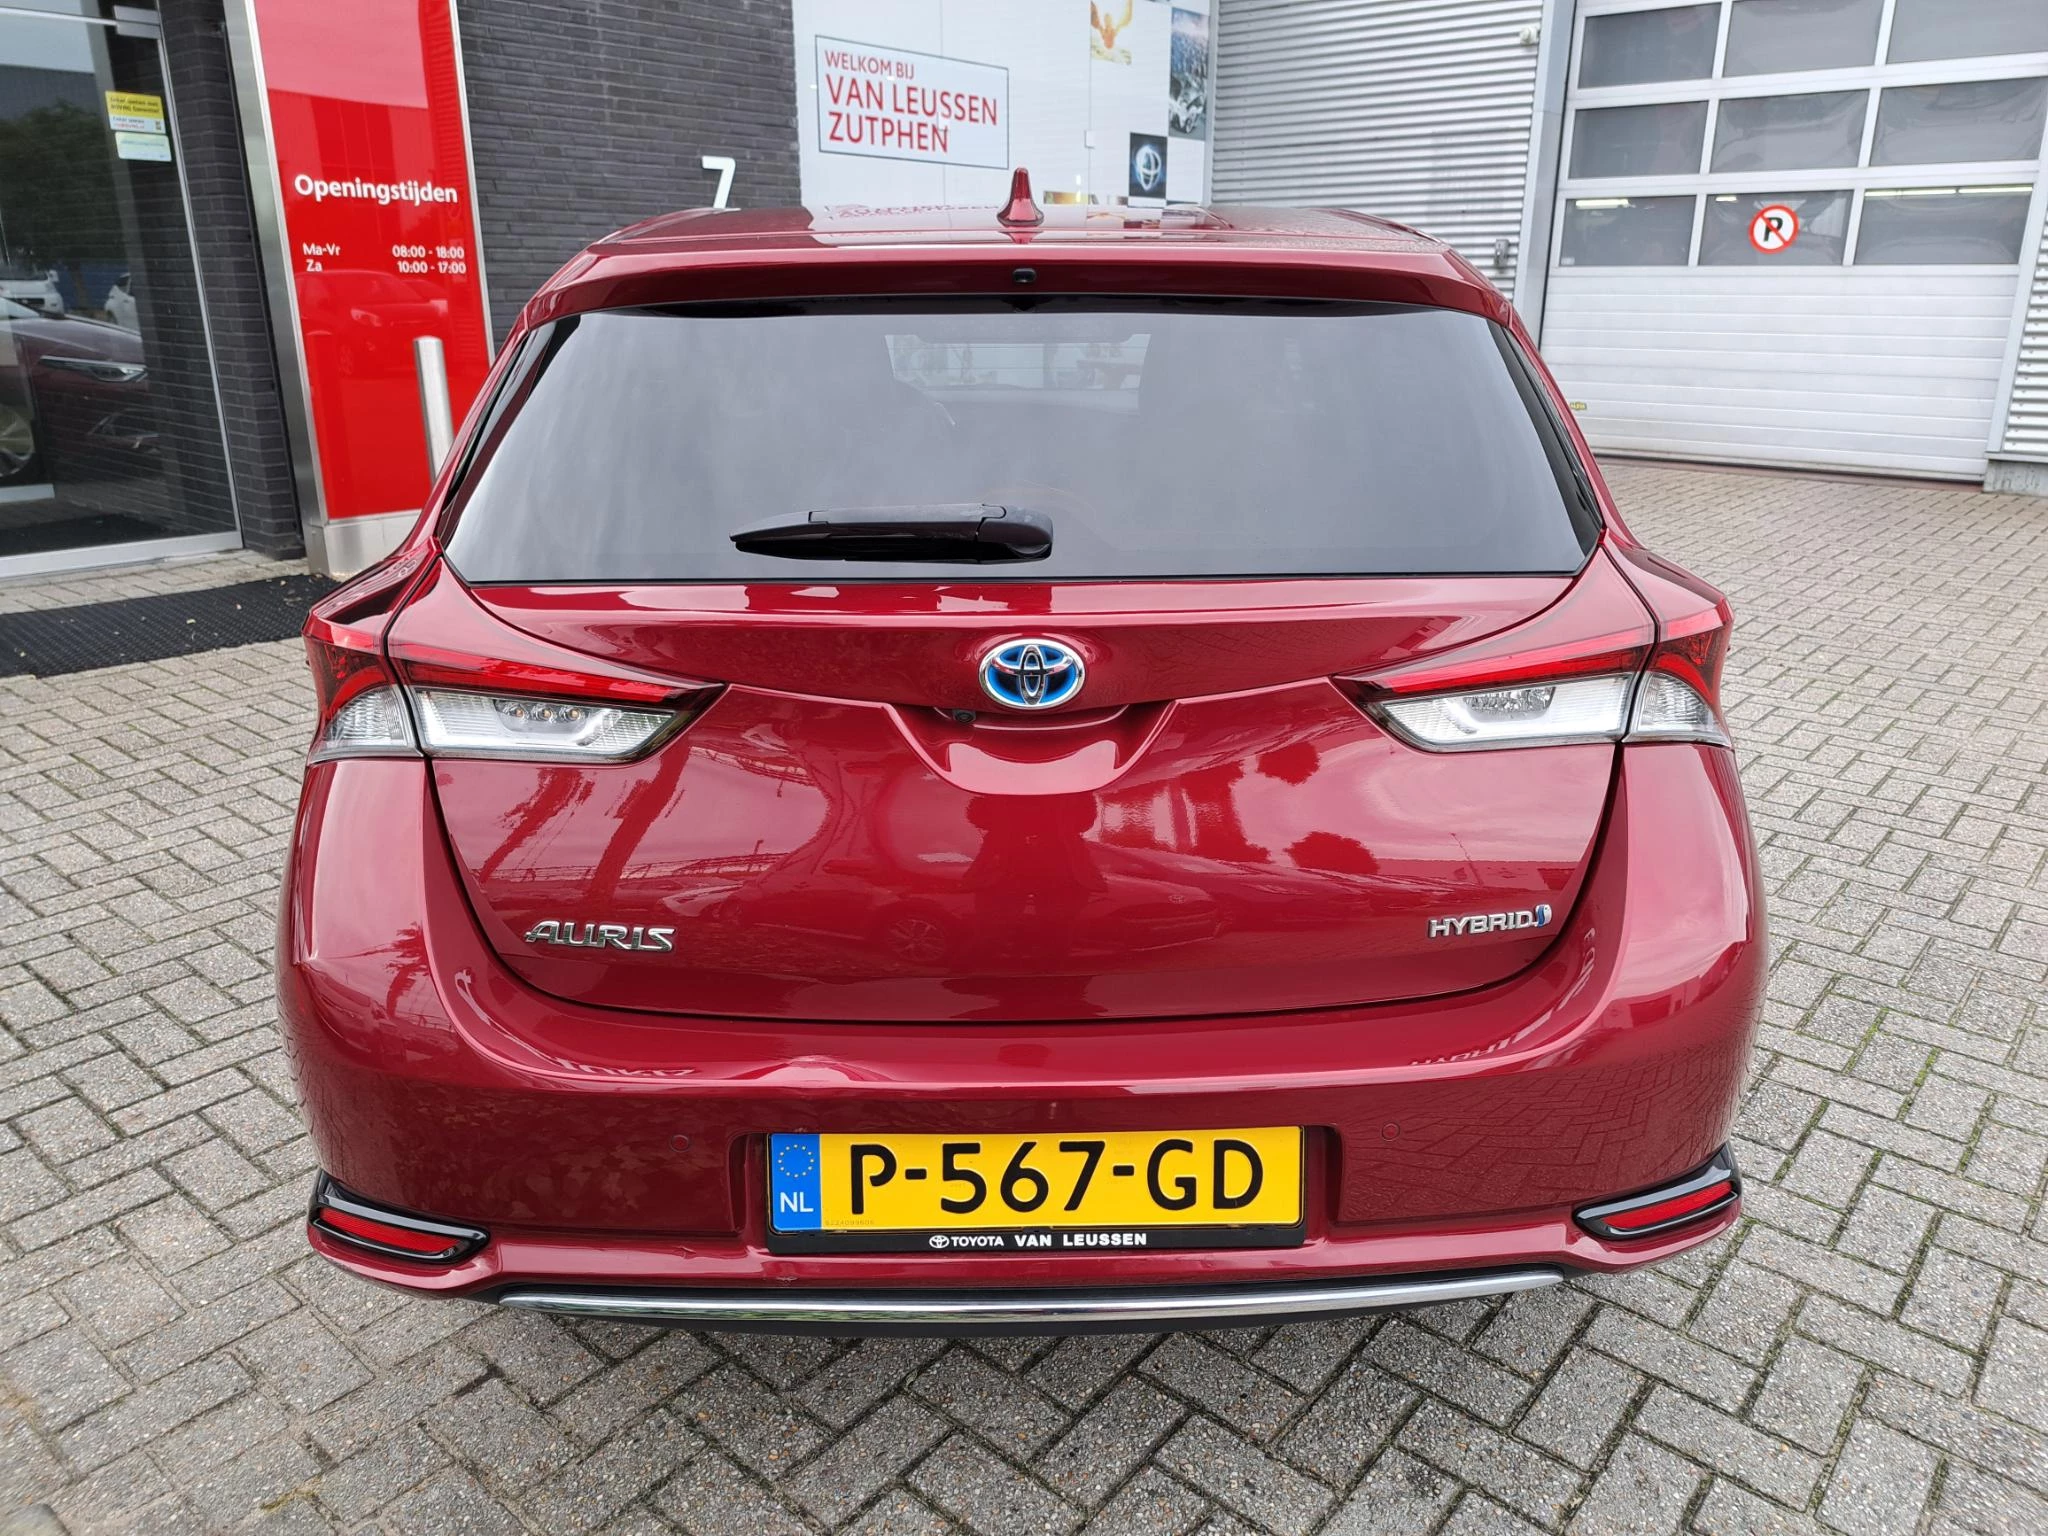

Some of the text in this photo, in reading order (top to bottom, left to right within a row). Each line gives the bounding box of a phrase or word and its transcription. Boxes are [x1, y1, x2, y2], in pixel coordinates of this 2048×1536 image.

[824, 50, 915, 80] WELKOM BIJ
[826, 73, 998, 126] VAN LEUSSEN
[828, 112, 948, 153] ZUTPHEN
[294, 174, 458, 206] Openingstijden
[702, 156, 736, 209] 7
[1763, 216, 1784, 242] P
[302, 242, 341, 256] Ma-Vr
[391, 244, 426, 258] 08:00
[435, 245, 465, 259] 18:00
[306, 259, 323, 272] Za
[397, 260, 428, 273] 10:00
[437, 260, 467, 274] 17:00
[524, 920, 675, 951] AURIS
[1428, 910, 1534, 938] HYBRID
[850, 1138, 1264, 1215] P-567-GD
[780, 1192, 814, 1213] NL
[951, 1233, 1147, 1247] TOYOTA VAN LEUSSEN
